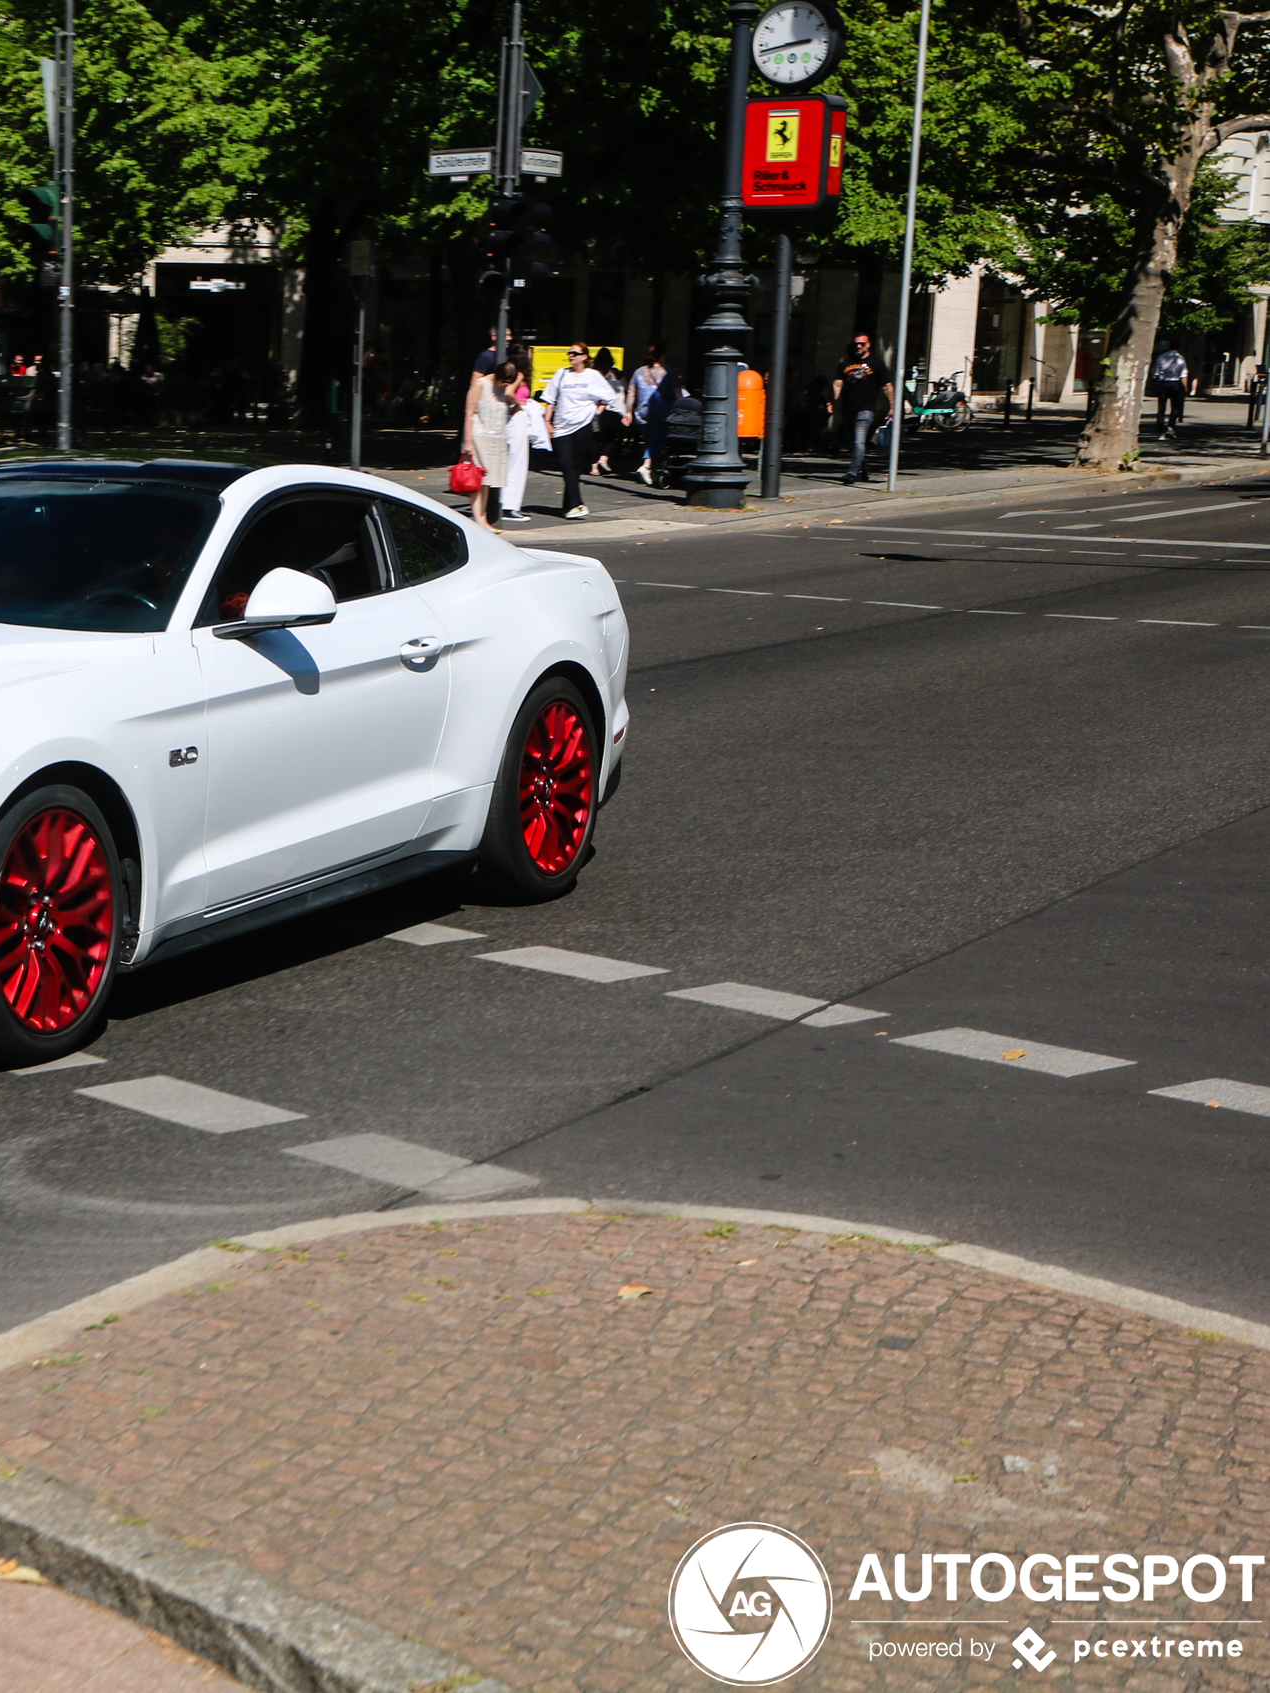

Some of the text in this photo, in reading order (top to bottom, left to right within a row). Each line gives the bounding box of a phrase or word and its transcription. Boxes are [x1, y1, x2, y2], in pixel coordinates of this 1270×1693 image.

[753, 170, 789, 180] Riller &
[753, 181, 807, 192] Schnauck
[169, 745, 198, 768] 5.0
